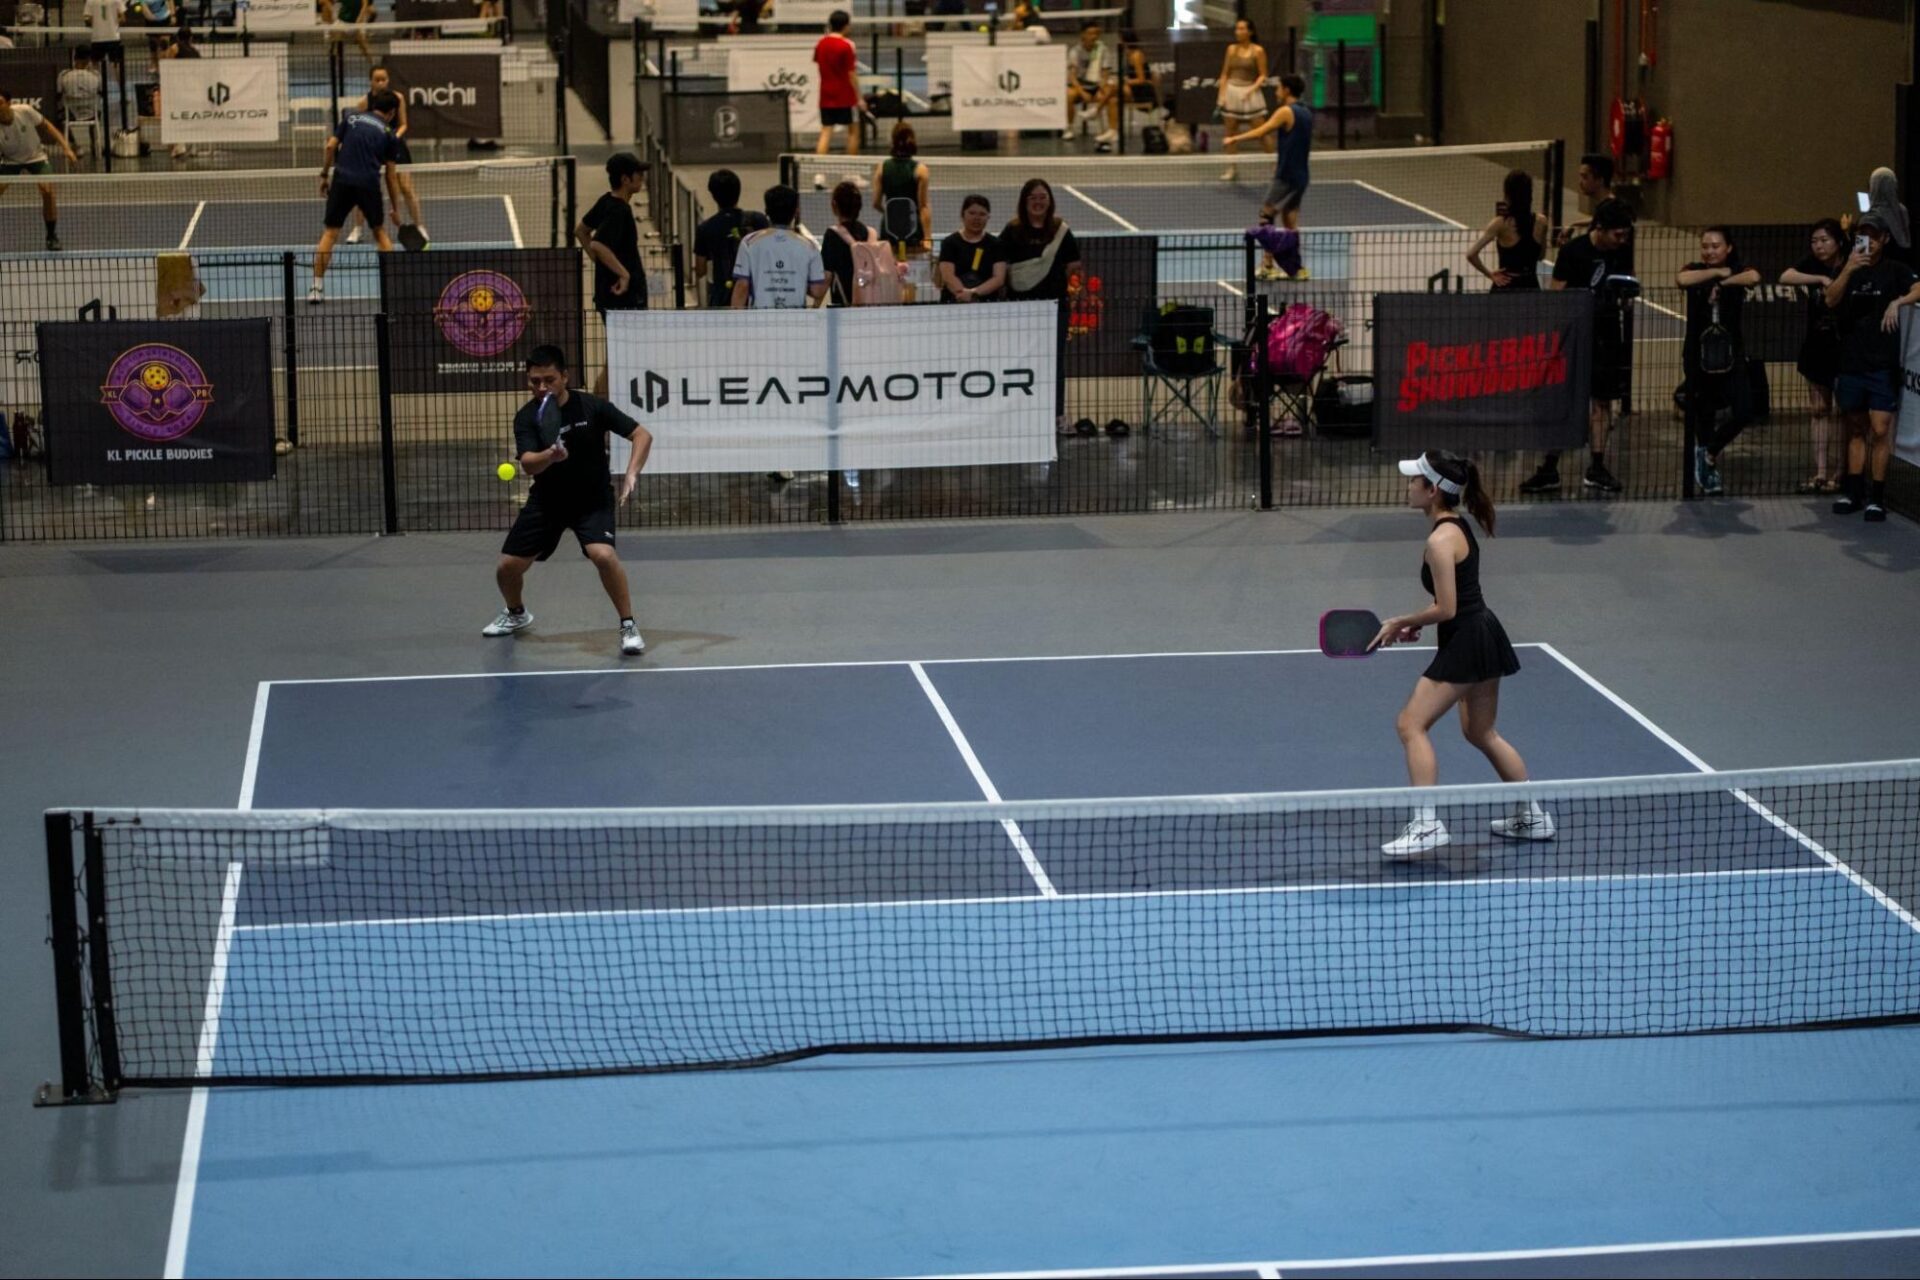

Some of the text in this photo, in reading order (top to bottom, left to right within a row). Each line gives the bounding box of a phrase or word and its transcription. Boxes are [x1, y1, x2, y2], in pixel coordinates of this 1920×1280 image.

[170, 109, 268, 120] LEAPMOTOR
[681, 368, 1035, 406] LEAPMOTOR
[107, 448, 213, 461] KL PICKLE BUDDIES
